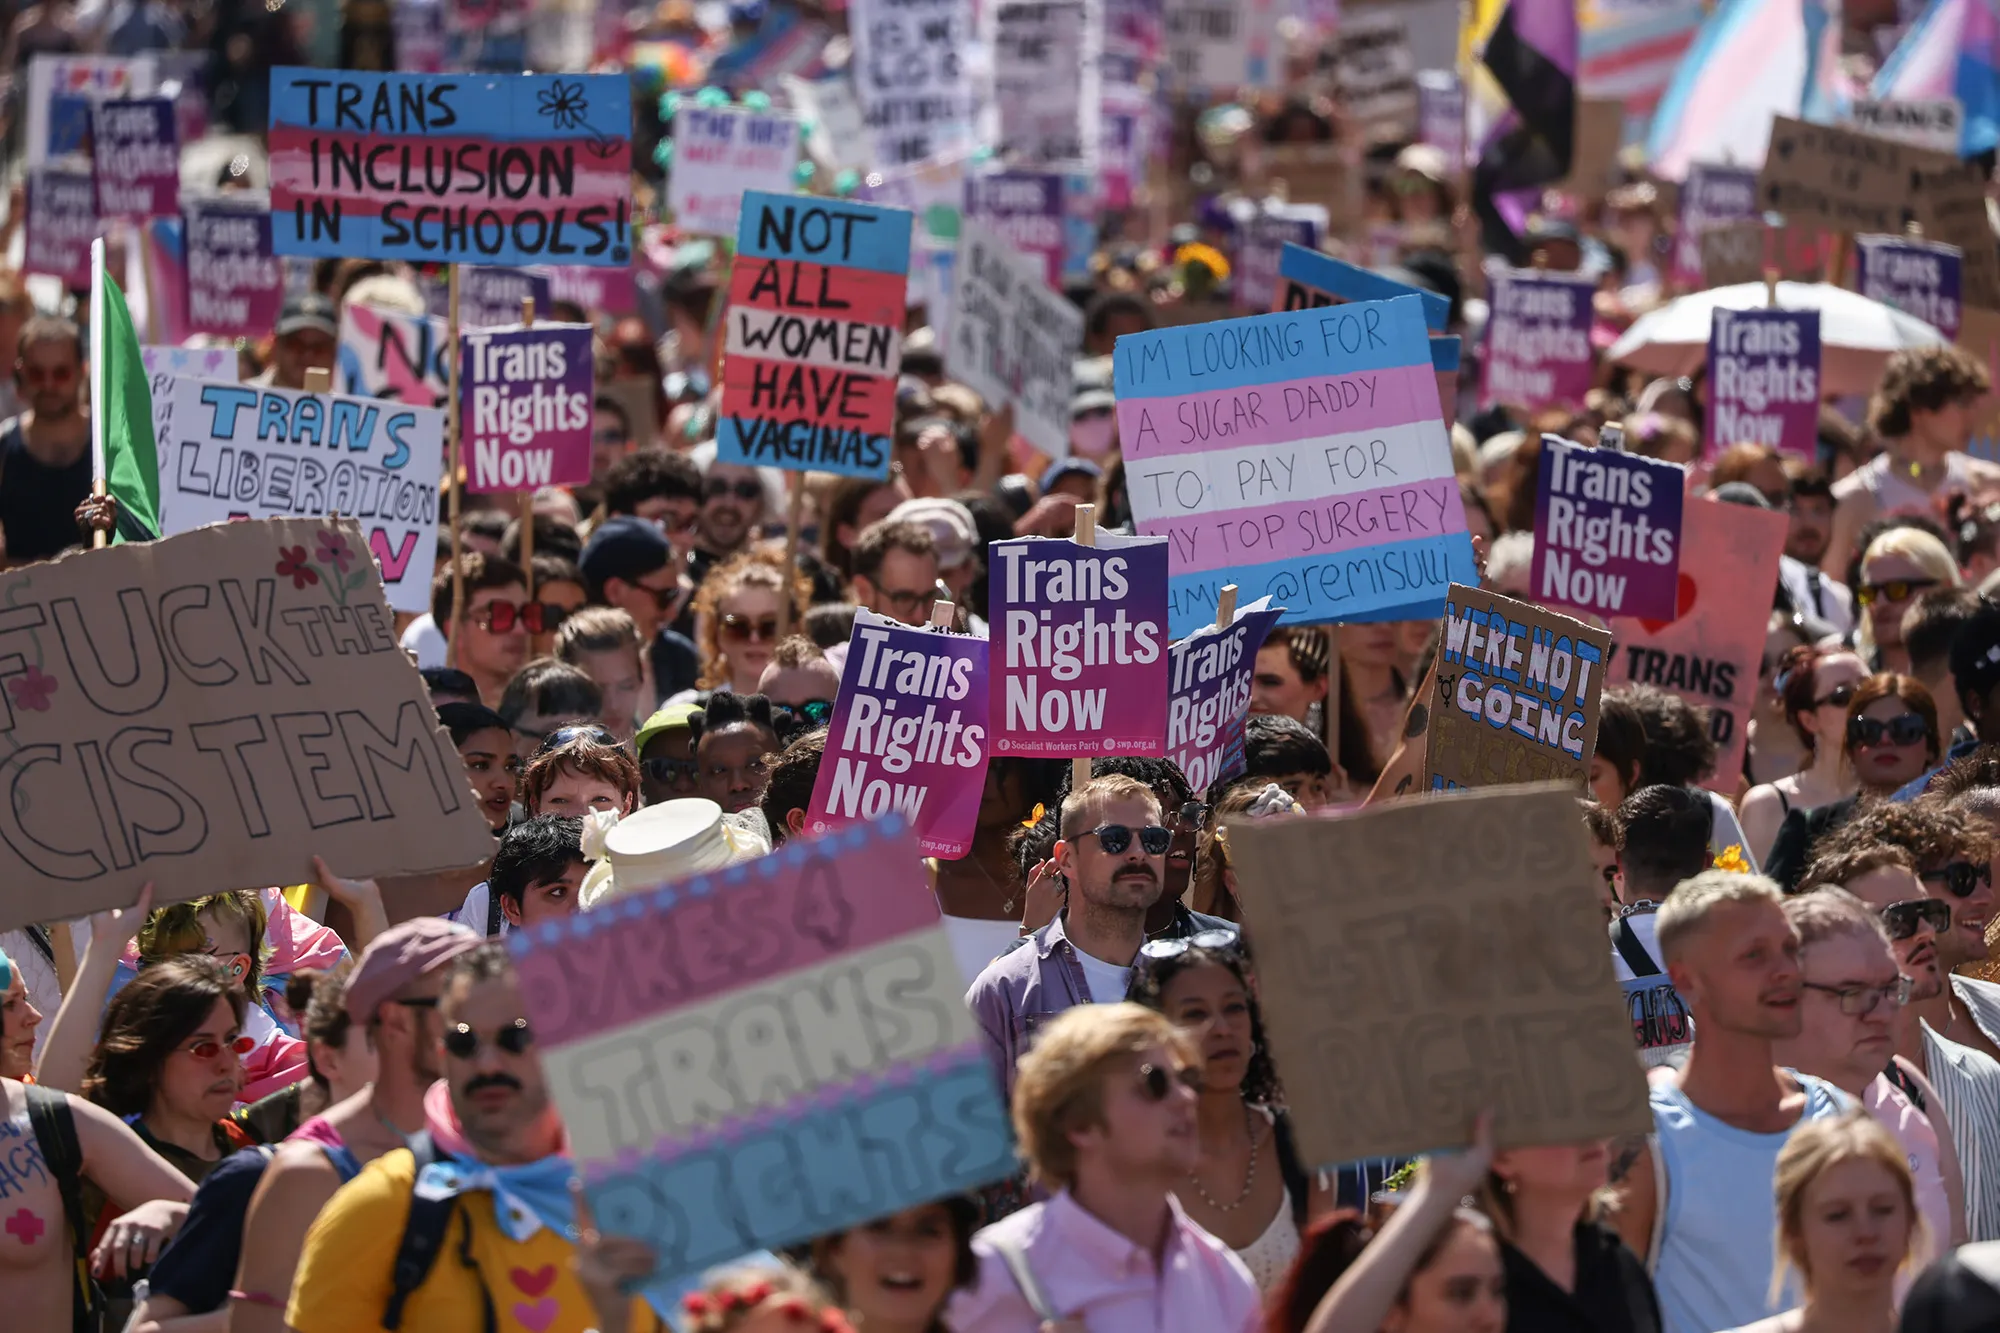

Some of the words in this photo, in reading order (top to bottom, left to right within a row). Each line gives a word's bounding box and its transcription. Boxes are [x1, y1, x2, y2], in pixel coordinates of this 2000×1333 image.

[290, 80, 458, 132] TRANS
[309, 138, 575, 200] INCLUSION
[295, 199, 342, 243] IN
[381, 198, 631, 264] SCHOOLS!
[757, 205, 878, 262] NOT
[749, 259, 851, 309] ALL
[1492, 279, 1575, 320] Trans
[466, 335, 568, 383] Trans
[738, 313, 892, 369] WOMEN
[1127, 338, 1172, 386] IM
[1185, 321, 1305, 377] LOOKING
[1319, 307, 1388, 357] FOR
[1493, 320, 1592, 365] Rights
[1715, 311, 1801, 356] Trans
[749, 362, 876, 420] HAVE
[1489, 359, 1556, 399] Now
[1716, 355, 1817, 411] Rights
[200, 385, 416, 470] TRANS
[473, 383, 590, 445] Rights
[732, 410, 889, 470] VAGINAS
[1135, 407, 1161, 452] A
[1177, 391, 1269, 445] SUGAR
[1283, 375, 1378, 424] DADDY
[1716, 402, 1784, 448] Now
[176, 441, 437, 526] LIBERATION
[474, 437, 554, 488] Now
[1143, 469, 1204, 510] TO
[1236, 452, 1296, 501] PAY
[1325, 438, 1399, 486] FOR
[1546, 441, 1654, 509] Trans
[1217, 514, 1286, 554] TOP
[1297, 485, 1449, 553] SURGERY
[1546, 494, 1675, 567] Rights
[997, 544, 1130, 604] Trans
[1541, 548, 1628, 611] Now
[0, 577, 311, 732] FUCK
[280, 602, 396, 656] THE
[856, 627, 974, 702] Trans
[1005, 606, 1161, 682] Rights
[1171, 626, 1248, 695] Trans
[1443, 601, 1528, 685] WE'RE
[1524, 624, 1601, 709] NOT
[1626, 643, 1738, 699] TRANS
[840, 692, 986, 775] Rights
[1005, 674, 1108, 734] Now
[1167, 668, 1252, 751] Rights
[1455, 671, 1587, 761] GOING
[1011, 740, 1044, 751] Socialist
[1046, 741, 1078, 752] Workers
[1079, 740, 1100, 752] Party
[1116, 740, 1157, 751] swp.org.uk
[0, 700, 461, 882] CISTEM
[824, 756, 928, 828] Now
[920, 838, 963, 855] swp.org.uk
[515, 882, 797, 1045] DYKES
[568, 942, 952, 1160] TRANS
[1308, 1001, 1646, 1148] RIGHTS
